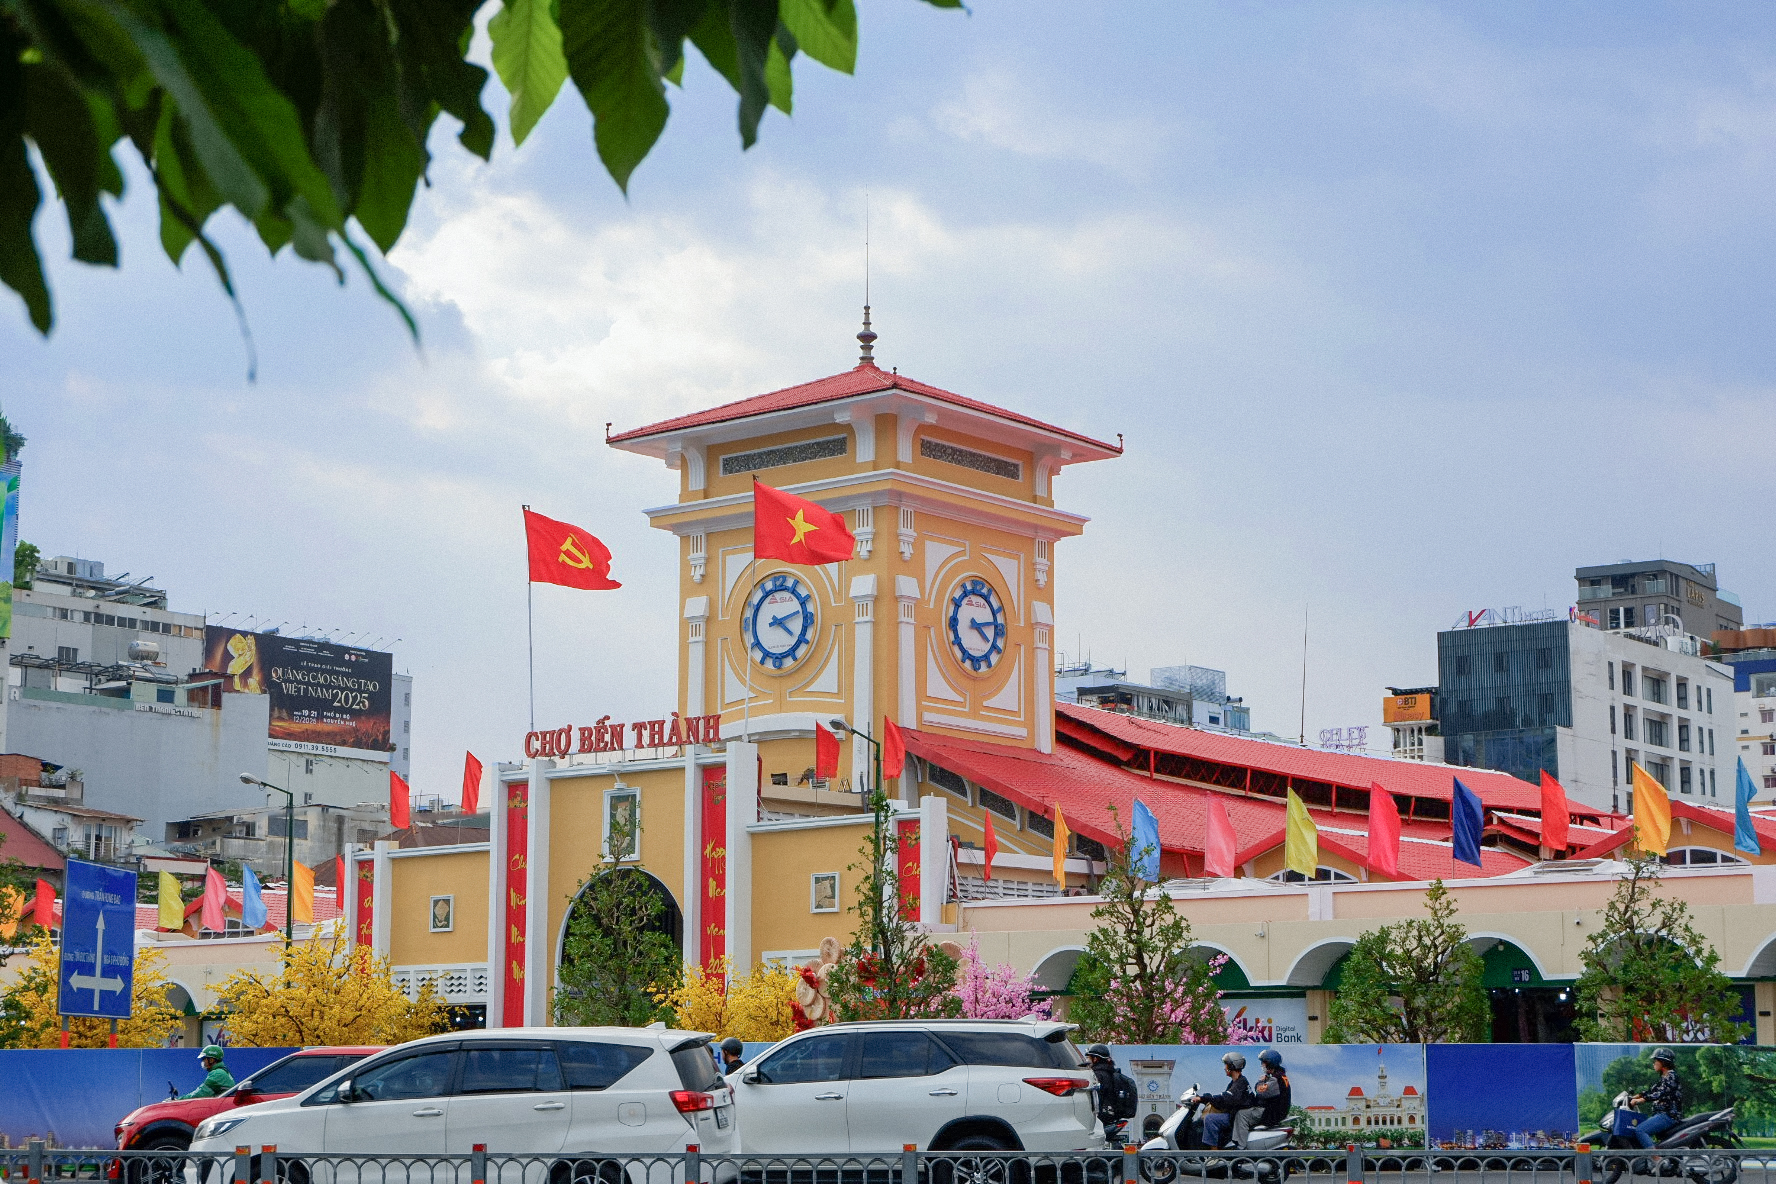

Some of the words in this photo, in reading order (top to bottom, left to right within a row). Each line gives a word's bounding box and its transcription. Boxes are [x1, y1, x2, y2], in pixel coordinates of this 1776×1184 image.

[271, 666, 308, 682] QUẢNG
[310, 671, 330, 685] CÁO
[331, 674, 358, 689] SÁNG
[282, 682, 307, 696] VIỆT
[308, 686, 332, 699] NAM
[332, 689, 369, 710] 2025
[524, 724, 572, 759] CHỢ
[578, 715, 625, 753] BẾN
[631, 712, 721, 749] THÀNH
[1521, 970, 1529, 981] 16
[1276, 1025, 1295, 1033] Digital
[1276, 1033, 1303, 1043] Bank
